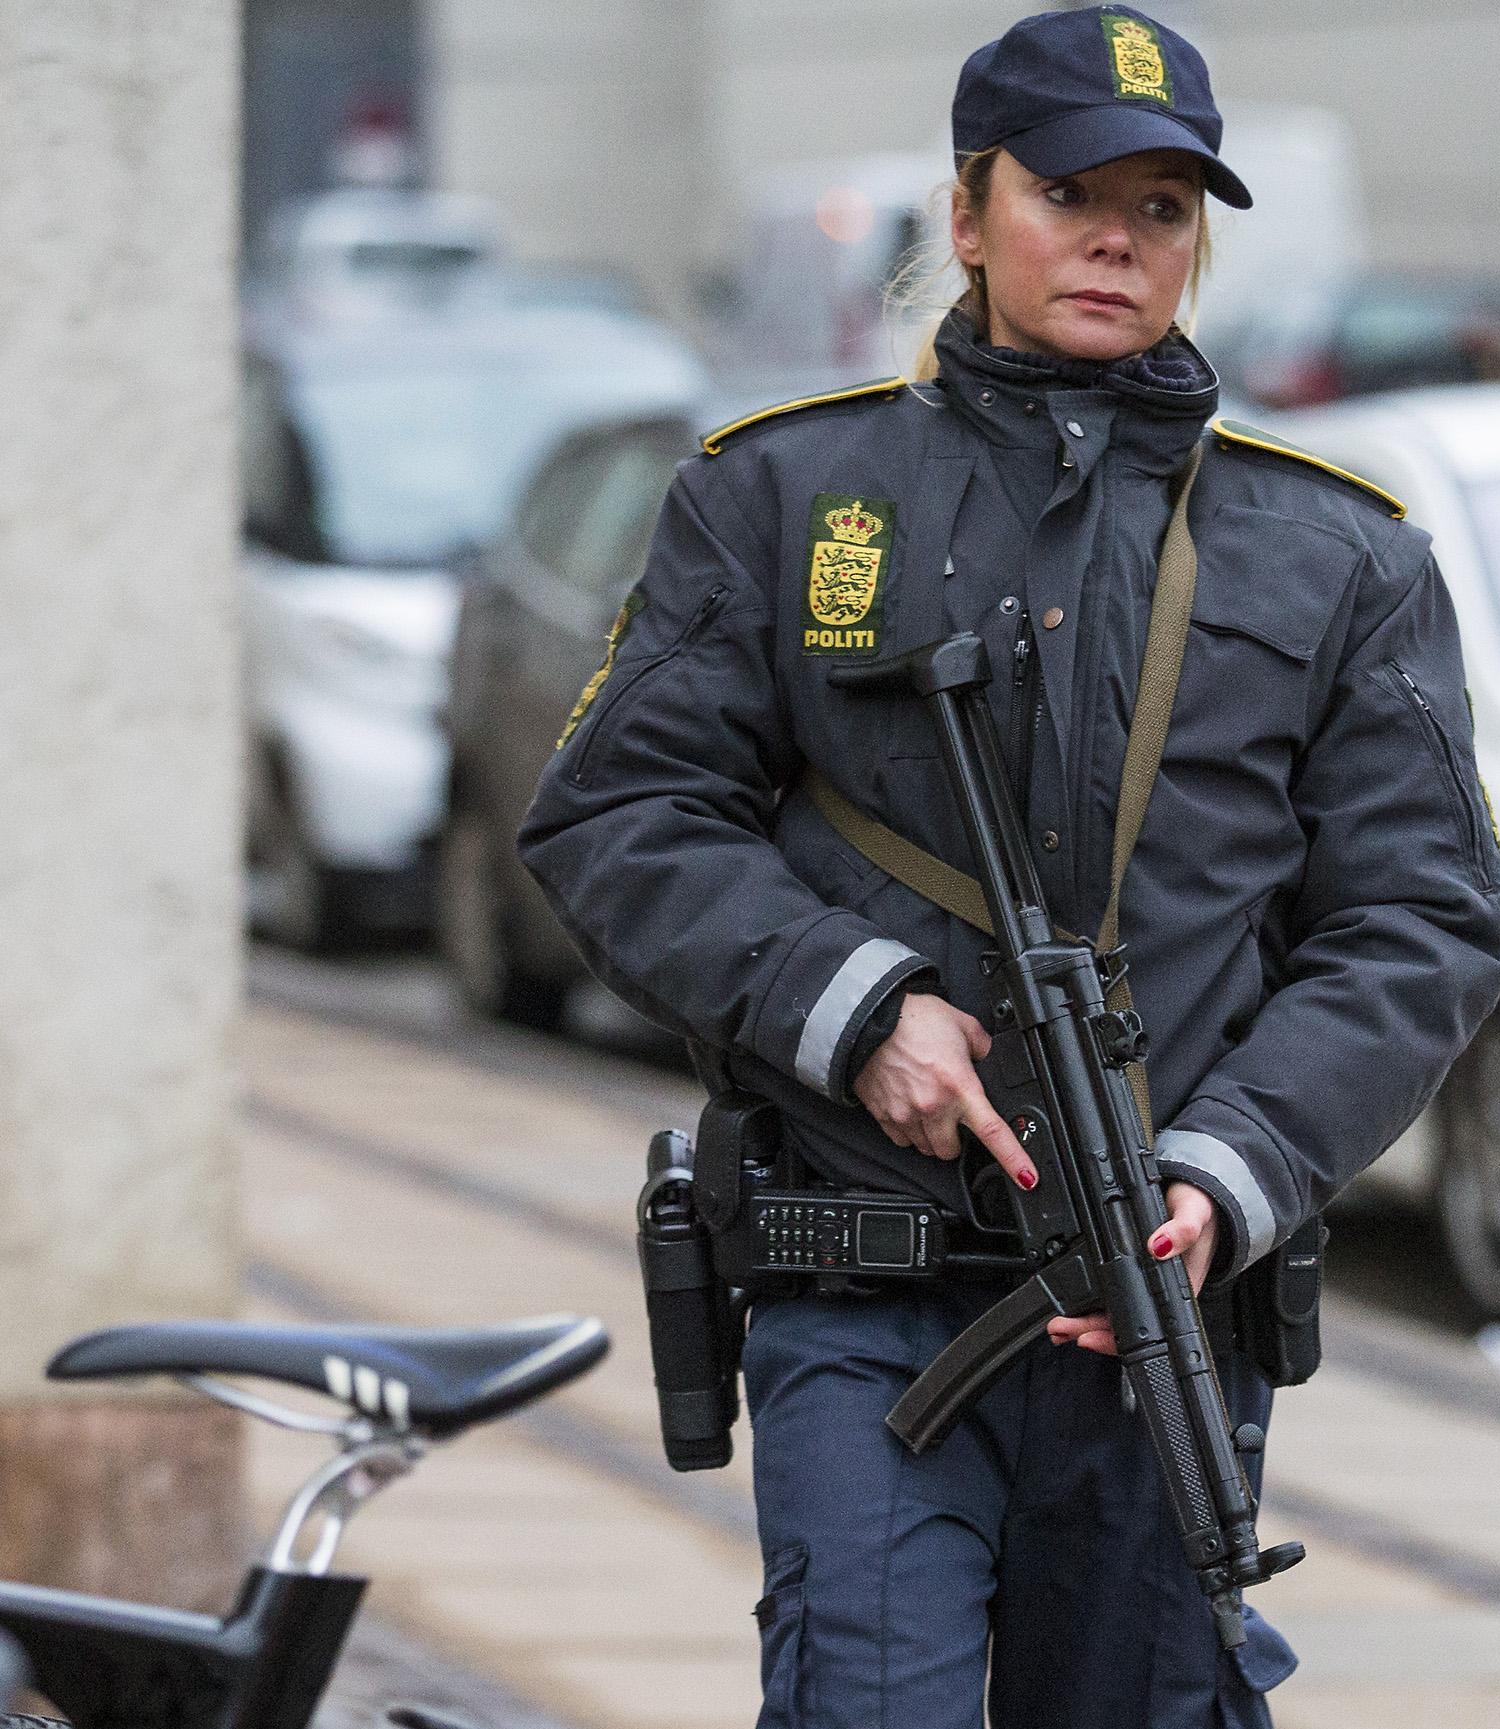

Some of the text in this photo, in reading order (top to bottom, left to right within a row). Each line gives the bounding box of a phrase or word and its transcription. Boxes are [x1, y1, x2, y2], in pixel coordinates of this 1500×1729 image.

[1121, 82, 1167, 101] POLITI
[804, 630, 875, 648] POLITI
[1028, 1121, 1037, 1132] S
